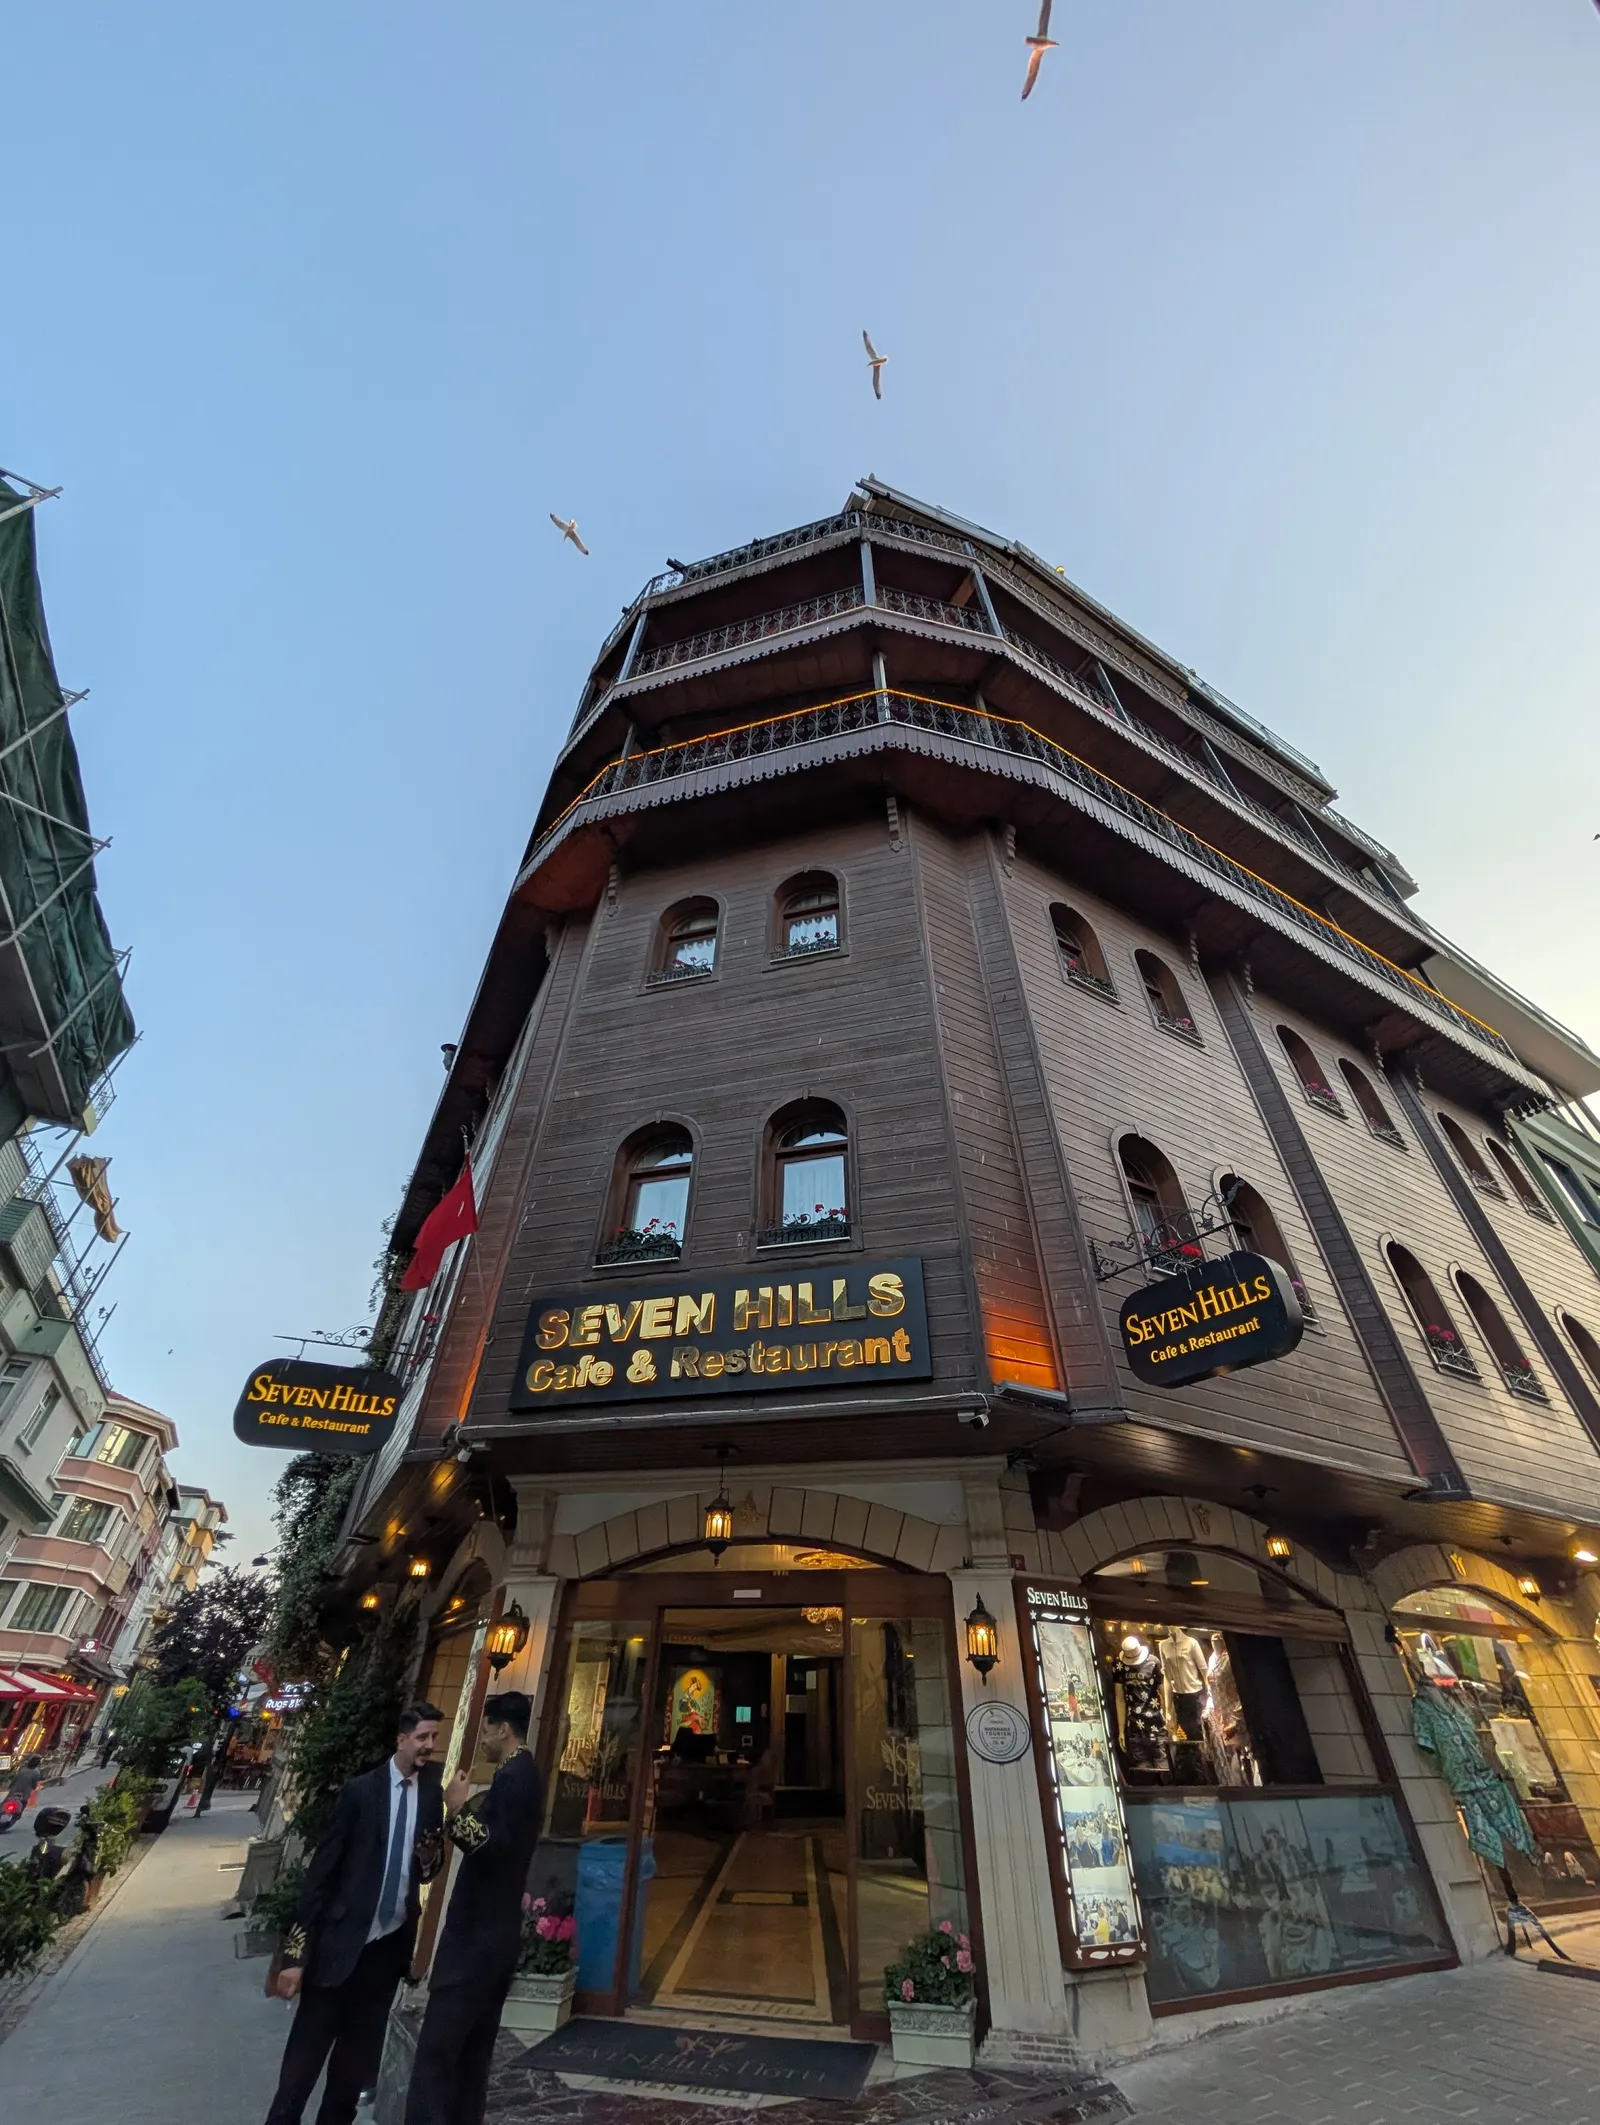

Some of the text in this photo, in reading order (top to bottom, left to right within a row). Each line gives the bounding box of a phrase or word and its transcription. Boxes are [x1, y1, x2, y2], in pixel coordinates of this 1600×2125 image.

[535, 1272, 906, 1350] SEVEN HILLS
[525, 1327, 912, 1392] Cafe & Restaurant
[1150, 1317, 1261, 1363] Cafe & Restaurant
[258, 1411, 371, 1434] Cafe & Restaurant
